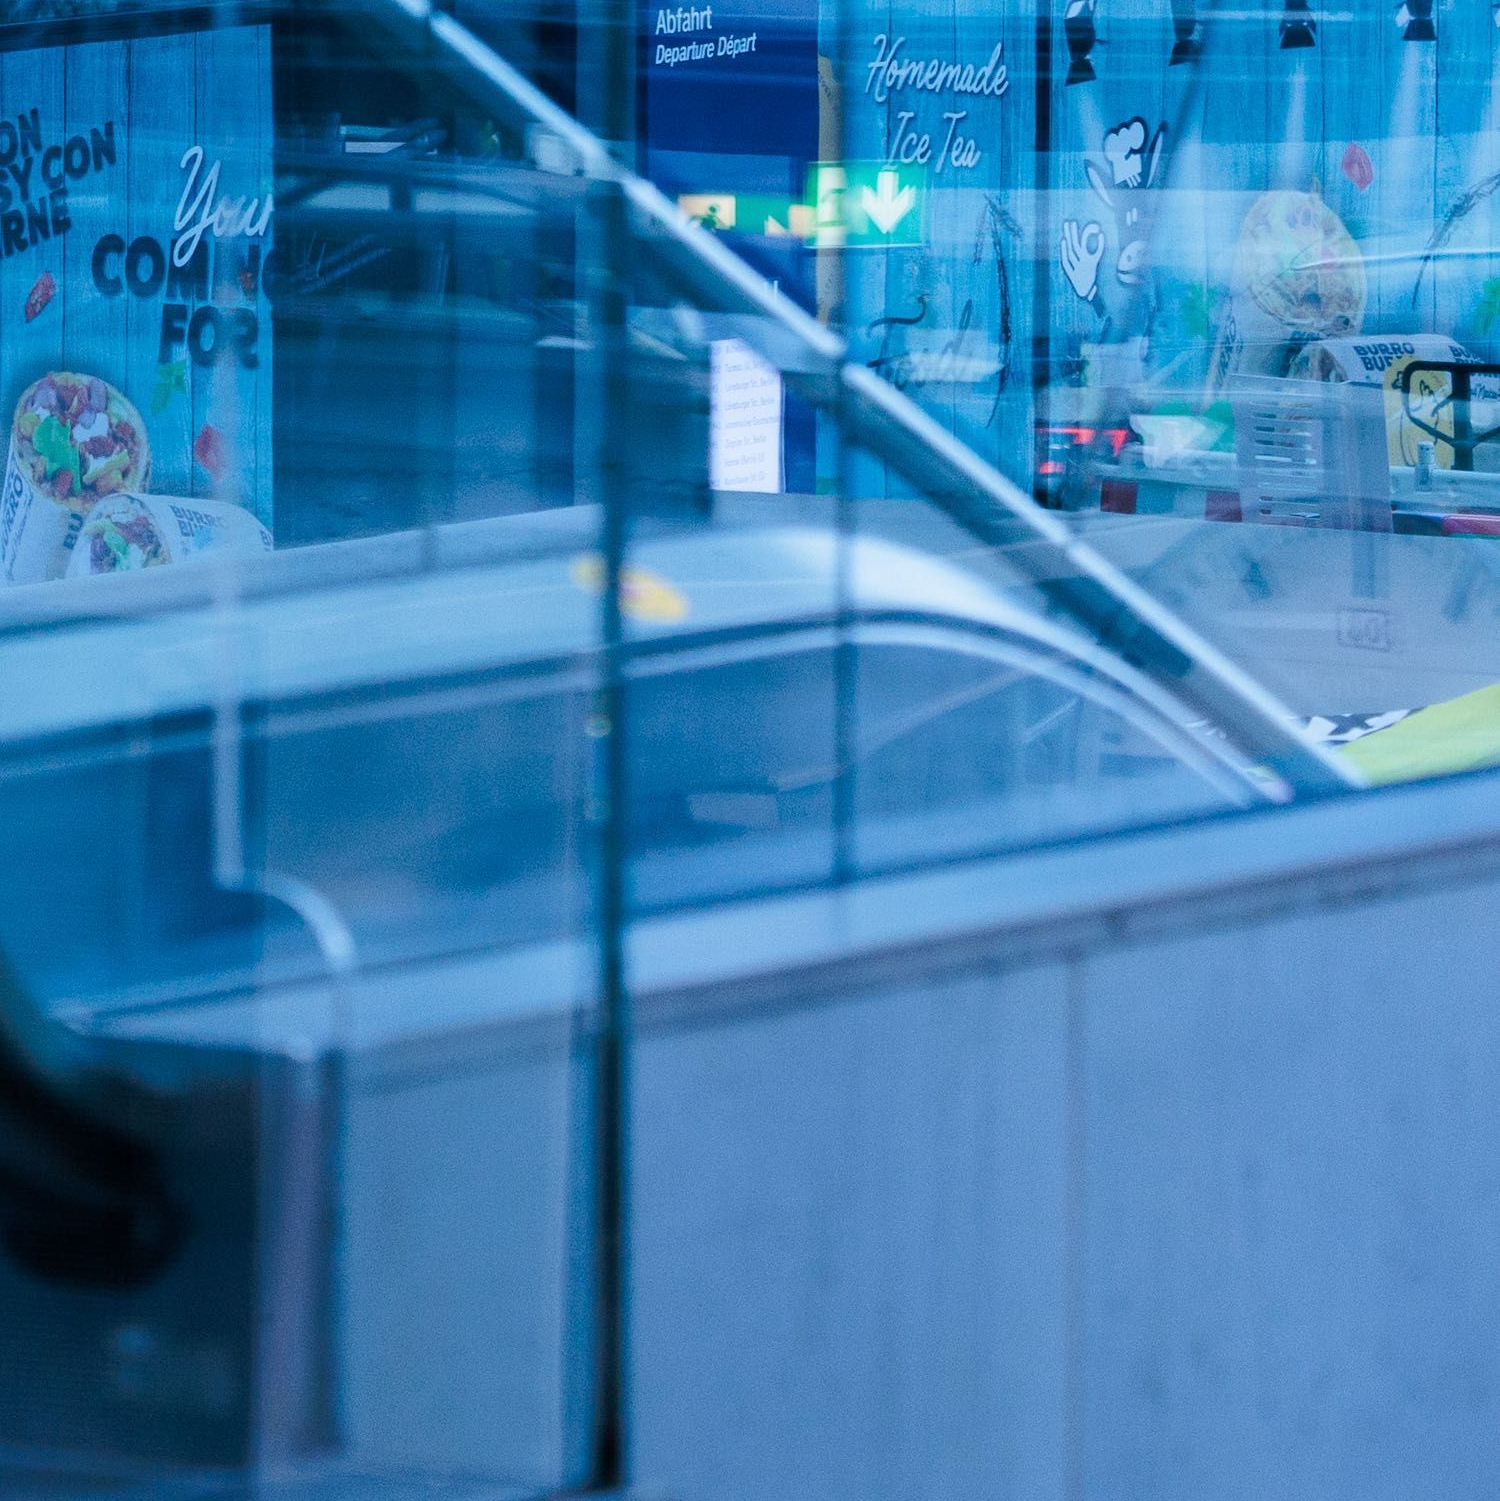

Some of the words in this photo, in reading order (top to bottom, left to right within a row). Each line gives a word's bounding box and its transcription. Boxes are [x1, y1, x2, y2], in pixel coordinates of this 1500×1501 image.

[656, 5, 713, 35] Abfahrt
[656, 39, 714, 67] Departure
[717, 32, 756, 58] Départ
[865, 33, 1009, 103] Homemade
[41, 120, 117, 190] CON
[883, 110, 931, 171] Ice
[935, 110, 982, 173] Tea
